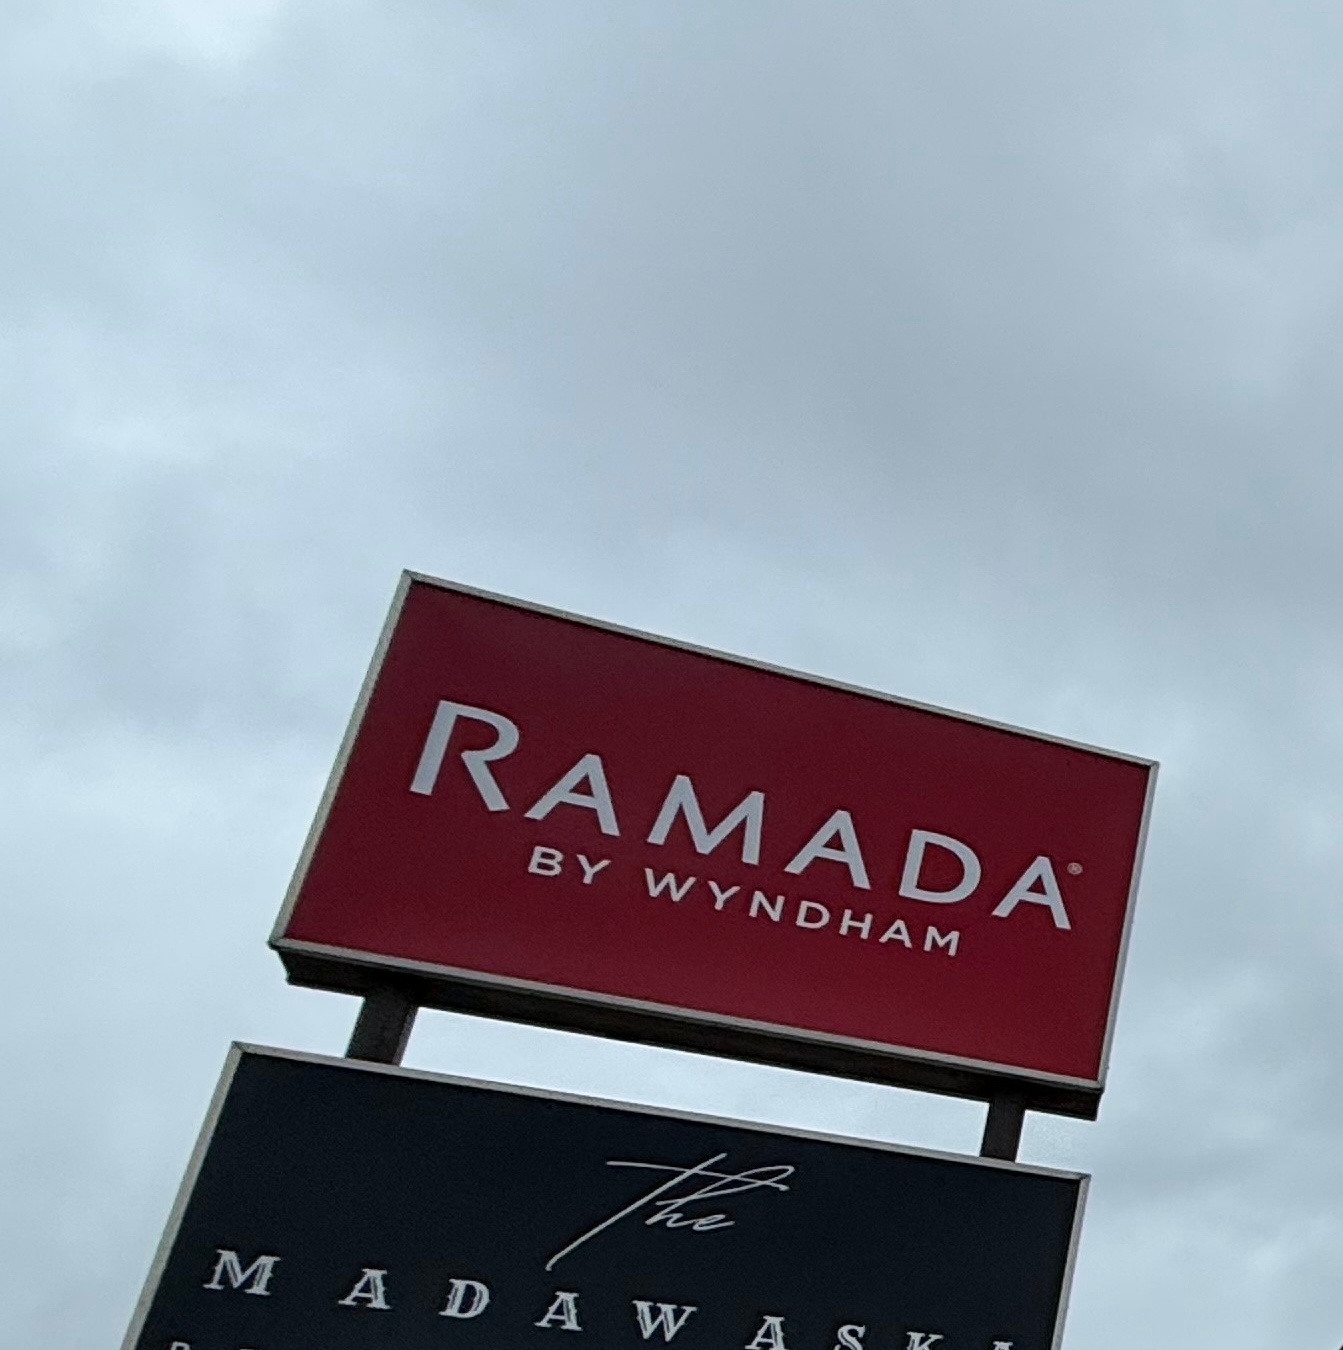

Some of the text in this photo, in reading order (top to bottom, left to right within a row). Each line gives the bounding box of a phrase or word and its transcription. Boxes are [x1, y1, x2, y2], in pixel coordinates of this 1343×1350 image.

[527, 845, 960, 957] BY WYNDHAM
[545, 1152, 795, 1271] The
